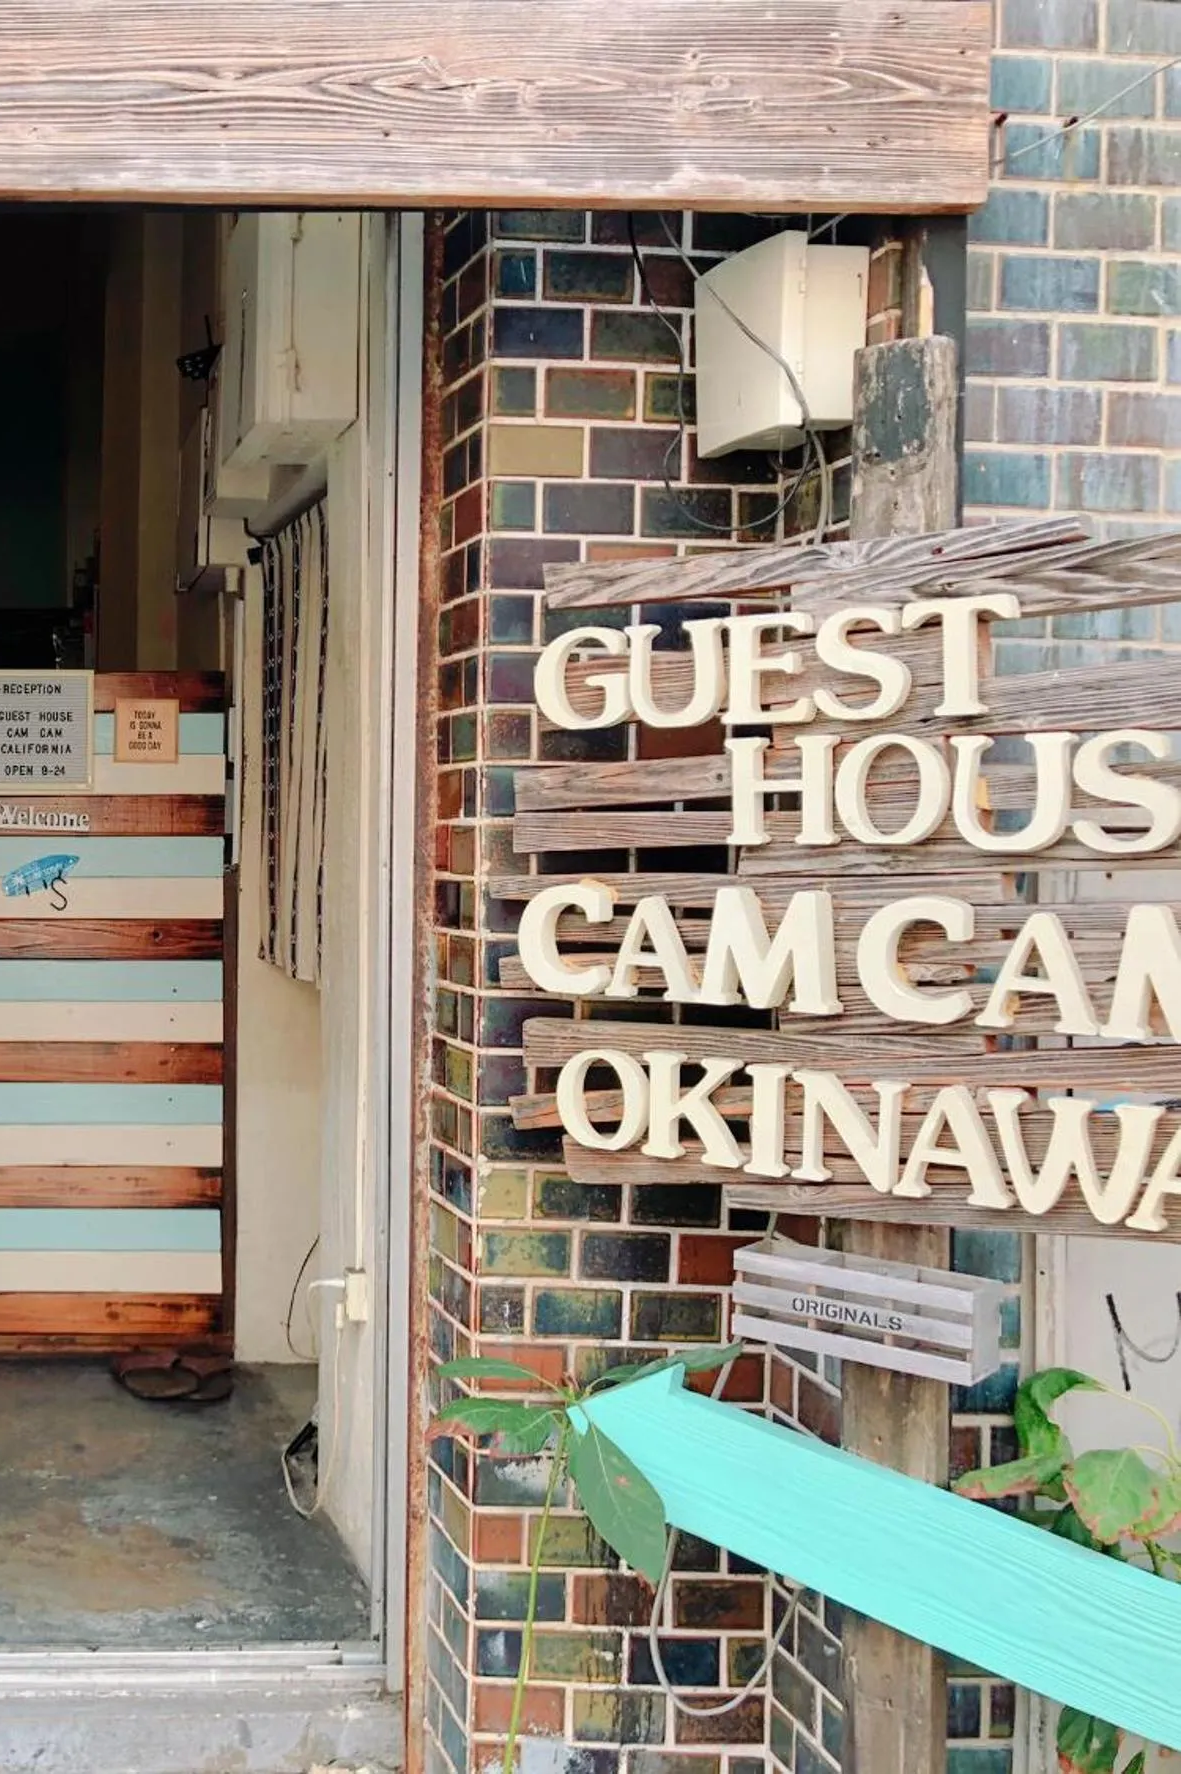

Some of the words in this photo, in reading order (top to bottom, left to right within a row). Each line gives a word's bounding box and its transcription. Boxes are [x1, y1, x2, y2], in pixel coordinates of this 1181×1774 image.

[534, 593, 1021, 729] GUEST
[2, 683, 62, 694] RECEPTION
[39, 711, 74, 722] HOUSE
[6, 727, 29, 738] CAM
[39, 727, 63, 738] CAM
[0, 743, 72, 755] CALIFORNIA
[4, 765, 34, 776] OPEN
[791, 1297, 903, 1332] ORIGINALS
